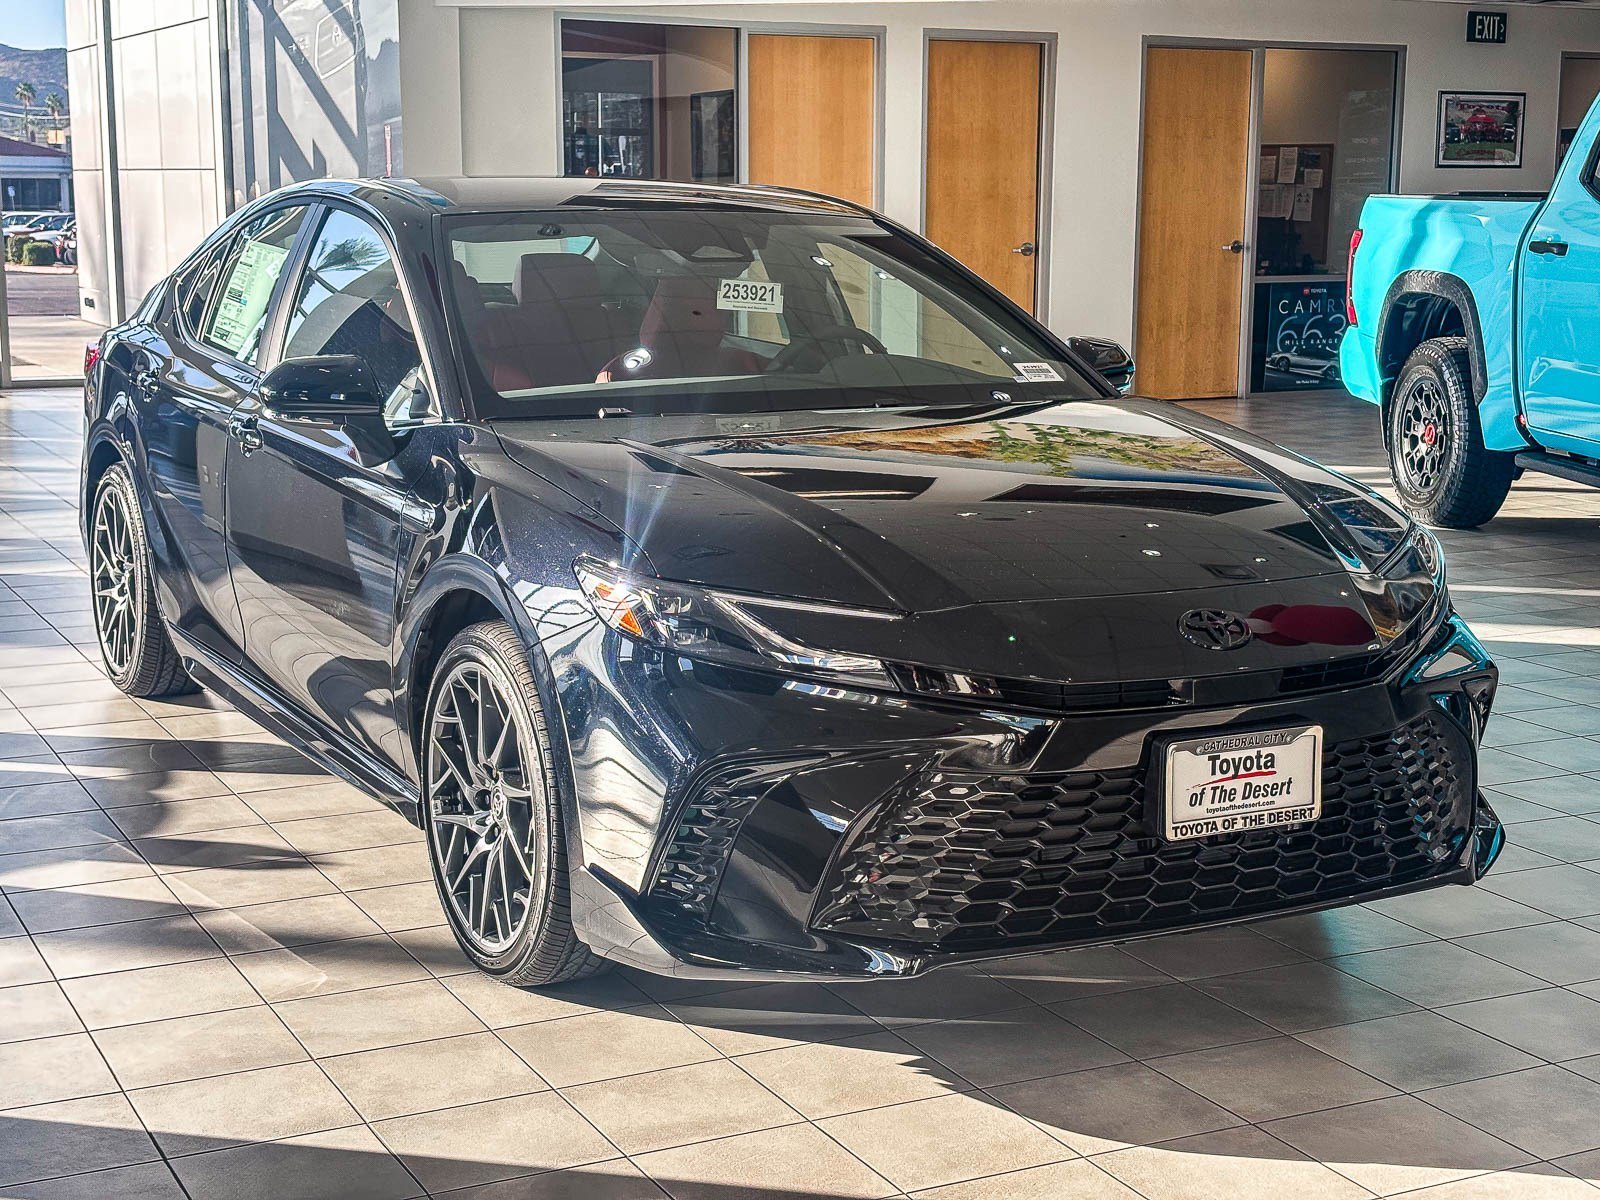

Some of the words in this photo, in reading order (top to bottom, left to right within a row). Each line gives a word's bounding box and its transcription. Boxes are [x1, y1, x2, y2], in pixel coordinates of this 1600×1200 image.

[1475, 15, 1500, 40] EXIT
[722, 283, 775, 302] 253921
[1203, 737, 1260, 751] CATHEDRAL
[1263, 732, 1287, 744] CITY
[1208, 750, 1275, 779] Toyota
[1189, 788, 1206, 807] of
[1210, 784, 1237, 804] The
[1242, 777, 1293, 800] Desert
[1206, 800, 1275, 814] toyotaofthedesert.com
[1172, 820, 1219, 838] TOYOTA
[1222, 818, 1238, 831] OF
[1241, 814, 1265, 829] THE
[1268, 807, 1315, 824] DESERT
